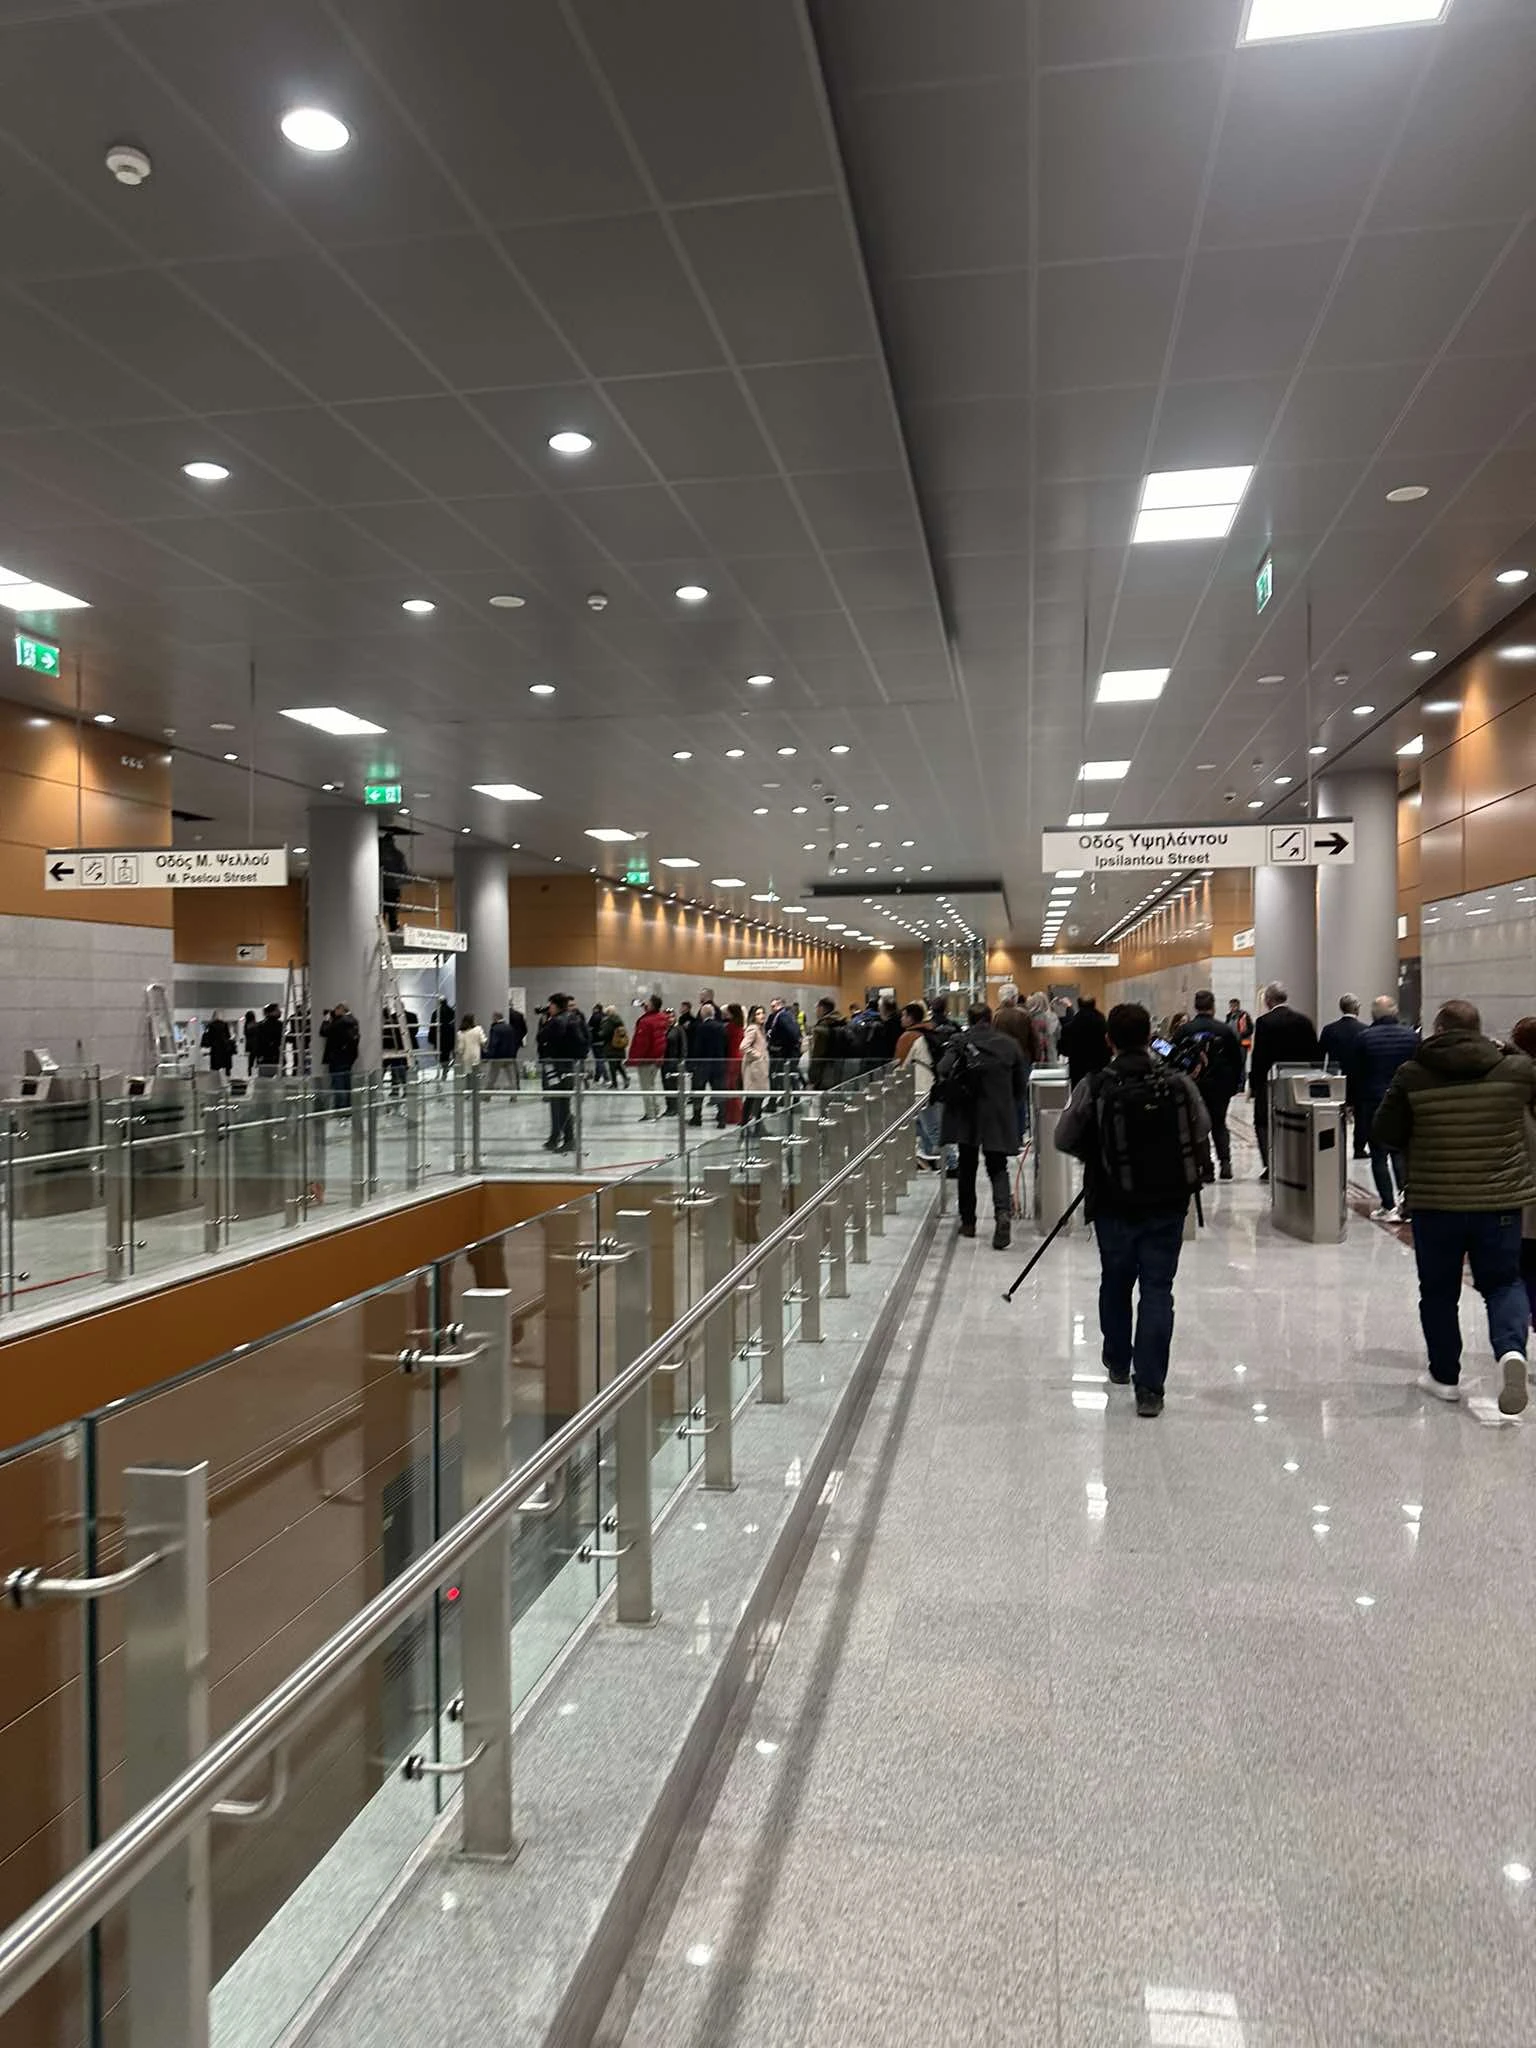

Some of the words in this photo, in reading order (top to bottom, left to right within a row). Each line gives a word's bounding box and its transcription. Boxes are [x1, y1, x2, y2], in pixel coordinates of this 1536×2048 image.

[1079, 833, 1124, 851] Οδός
[1129, 832, 1228, 850] Υψηλάντου
[155, 854, 193, 870] Οδός
[216, 853, 269, 867] Ψελλού
[1095, 855, 1164, 869] Ipsilantou
[1167, 852, 1210, 865] Street
[223, 871, 258, 882] Street
